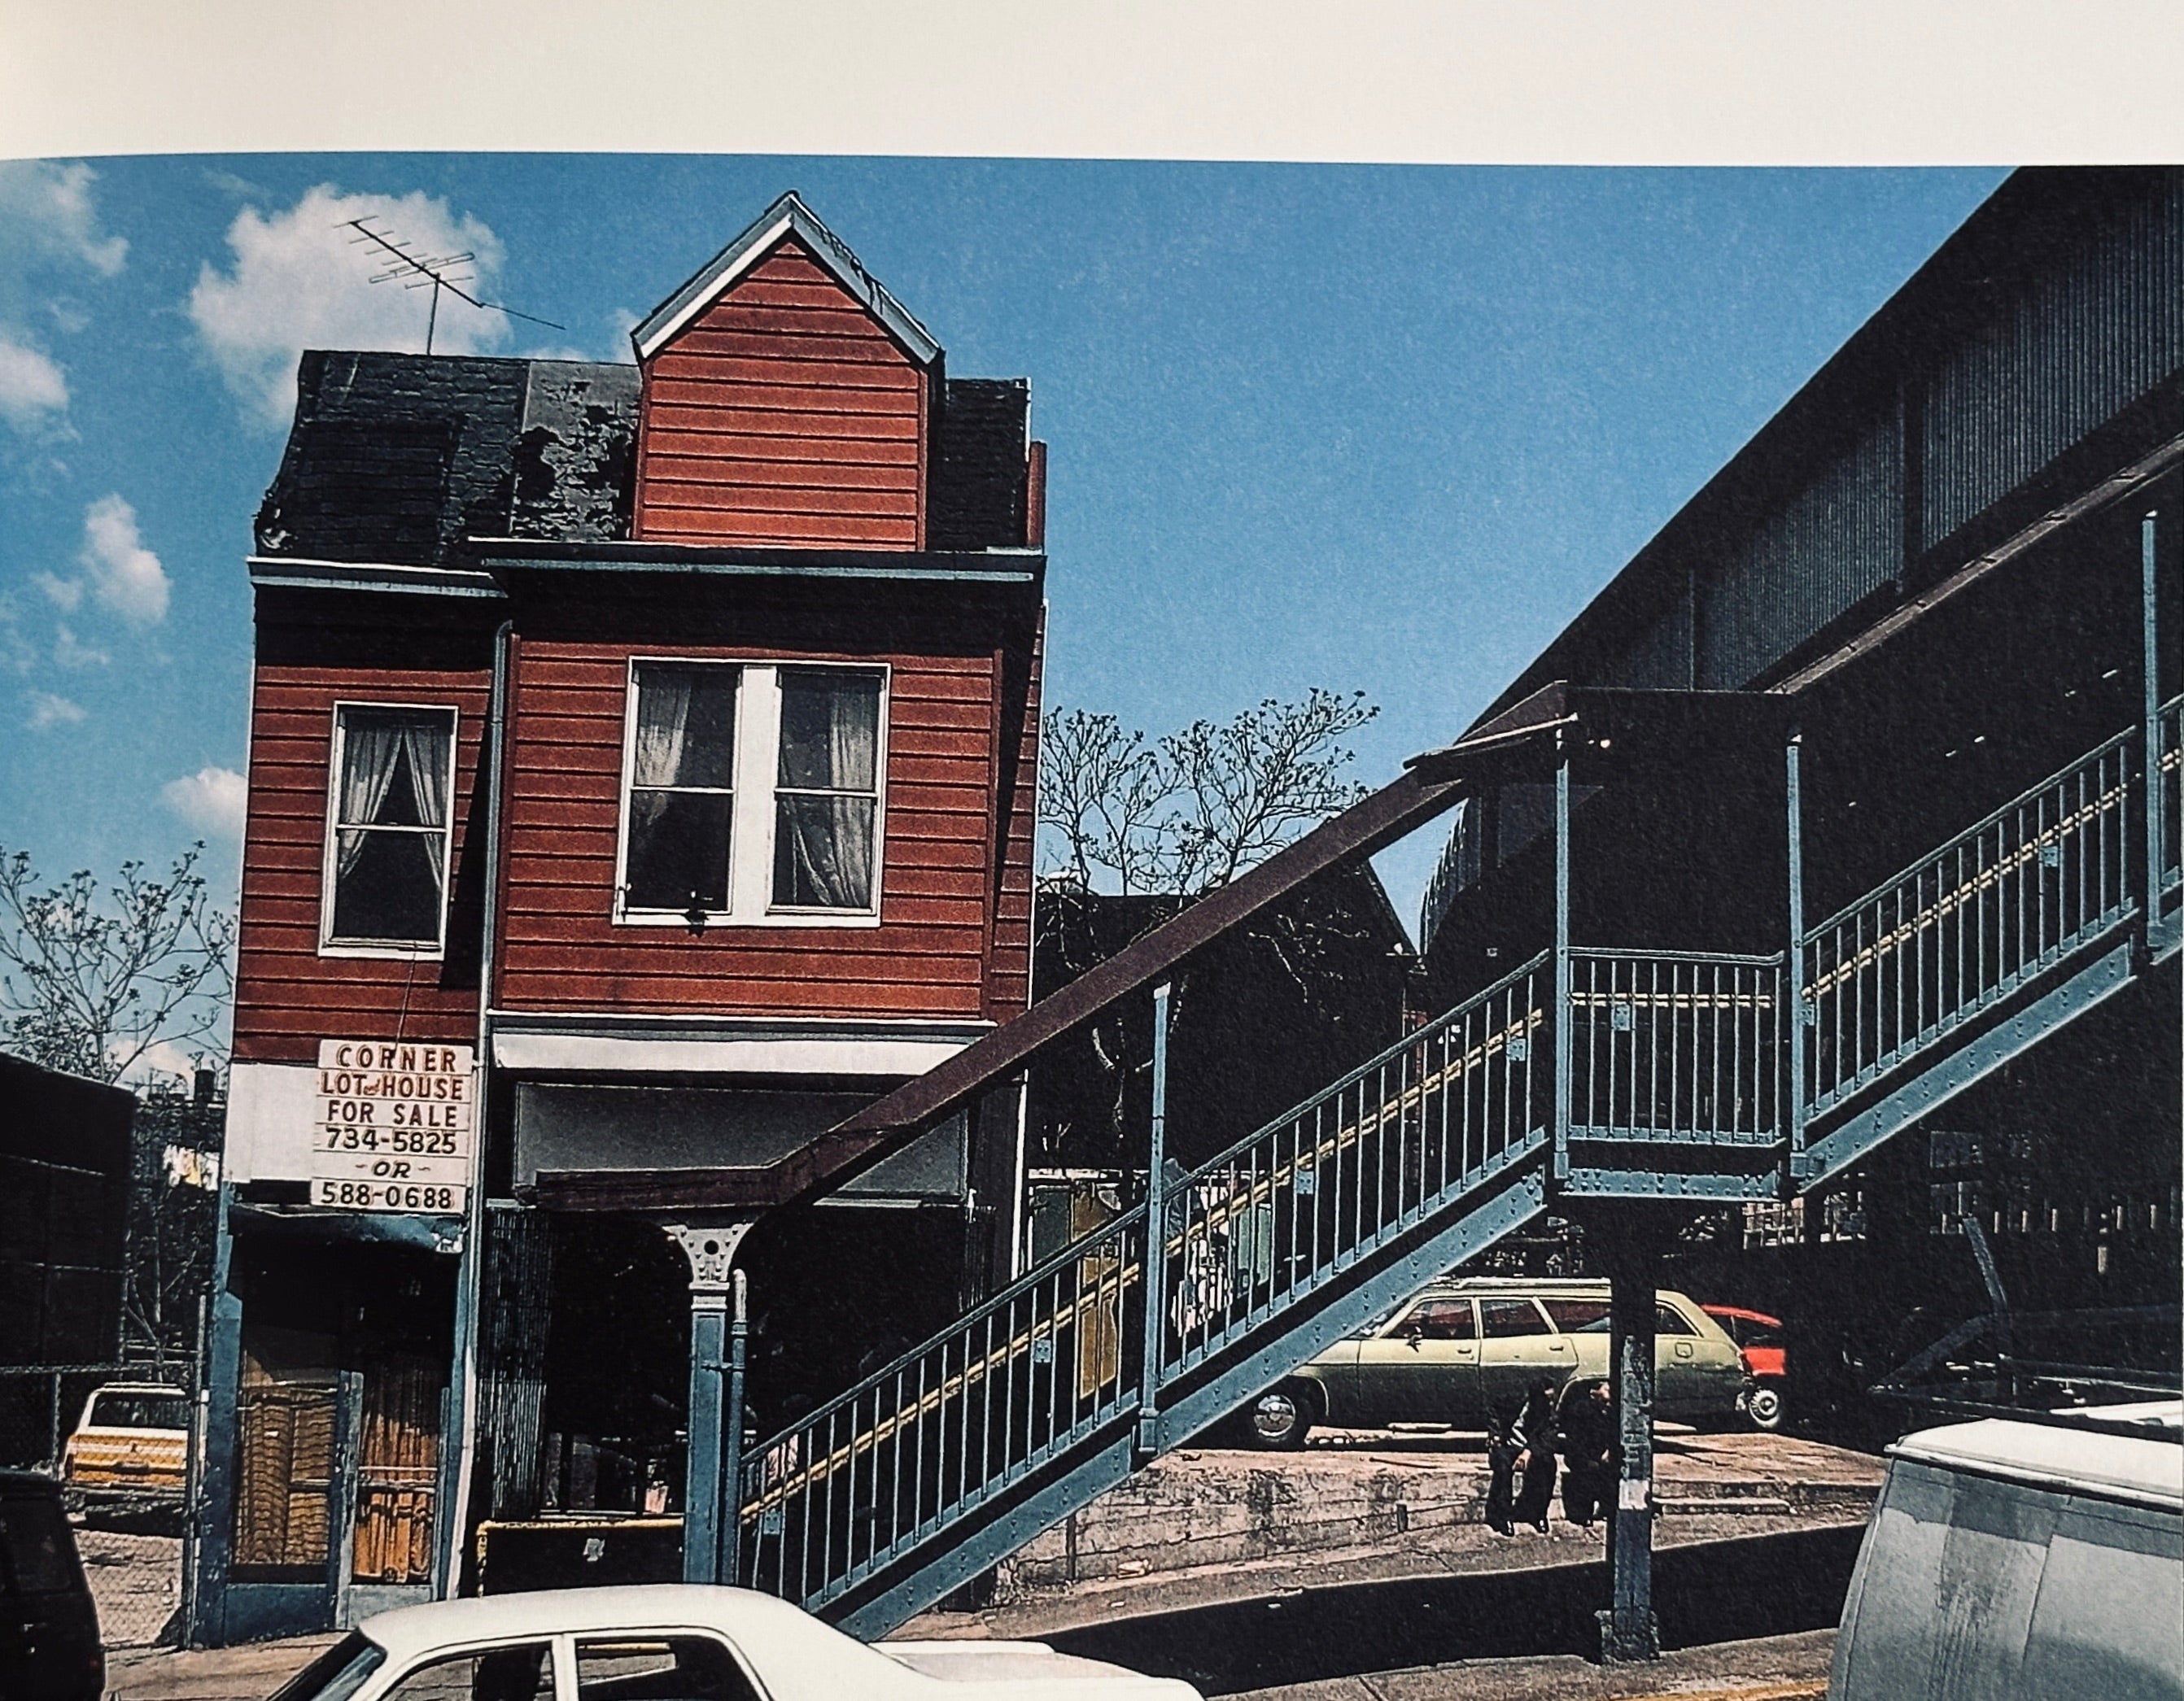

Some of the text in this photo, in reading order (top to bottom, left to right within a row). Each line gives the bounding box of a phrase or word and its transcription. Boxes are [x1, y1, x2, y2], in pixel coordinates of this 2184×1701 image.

[336, 1045, 456, 1072] CORNER
[321, 1071, 366, 1096] LOT
[382, 1072, 464, 1100] HOUSE
[327, 1100, 457, 1127] FOR SALE
[325, 1126, 456, 1154] 734-5825
[321, 1181, 454, 1209] 588-0688
